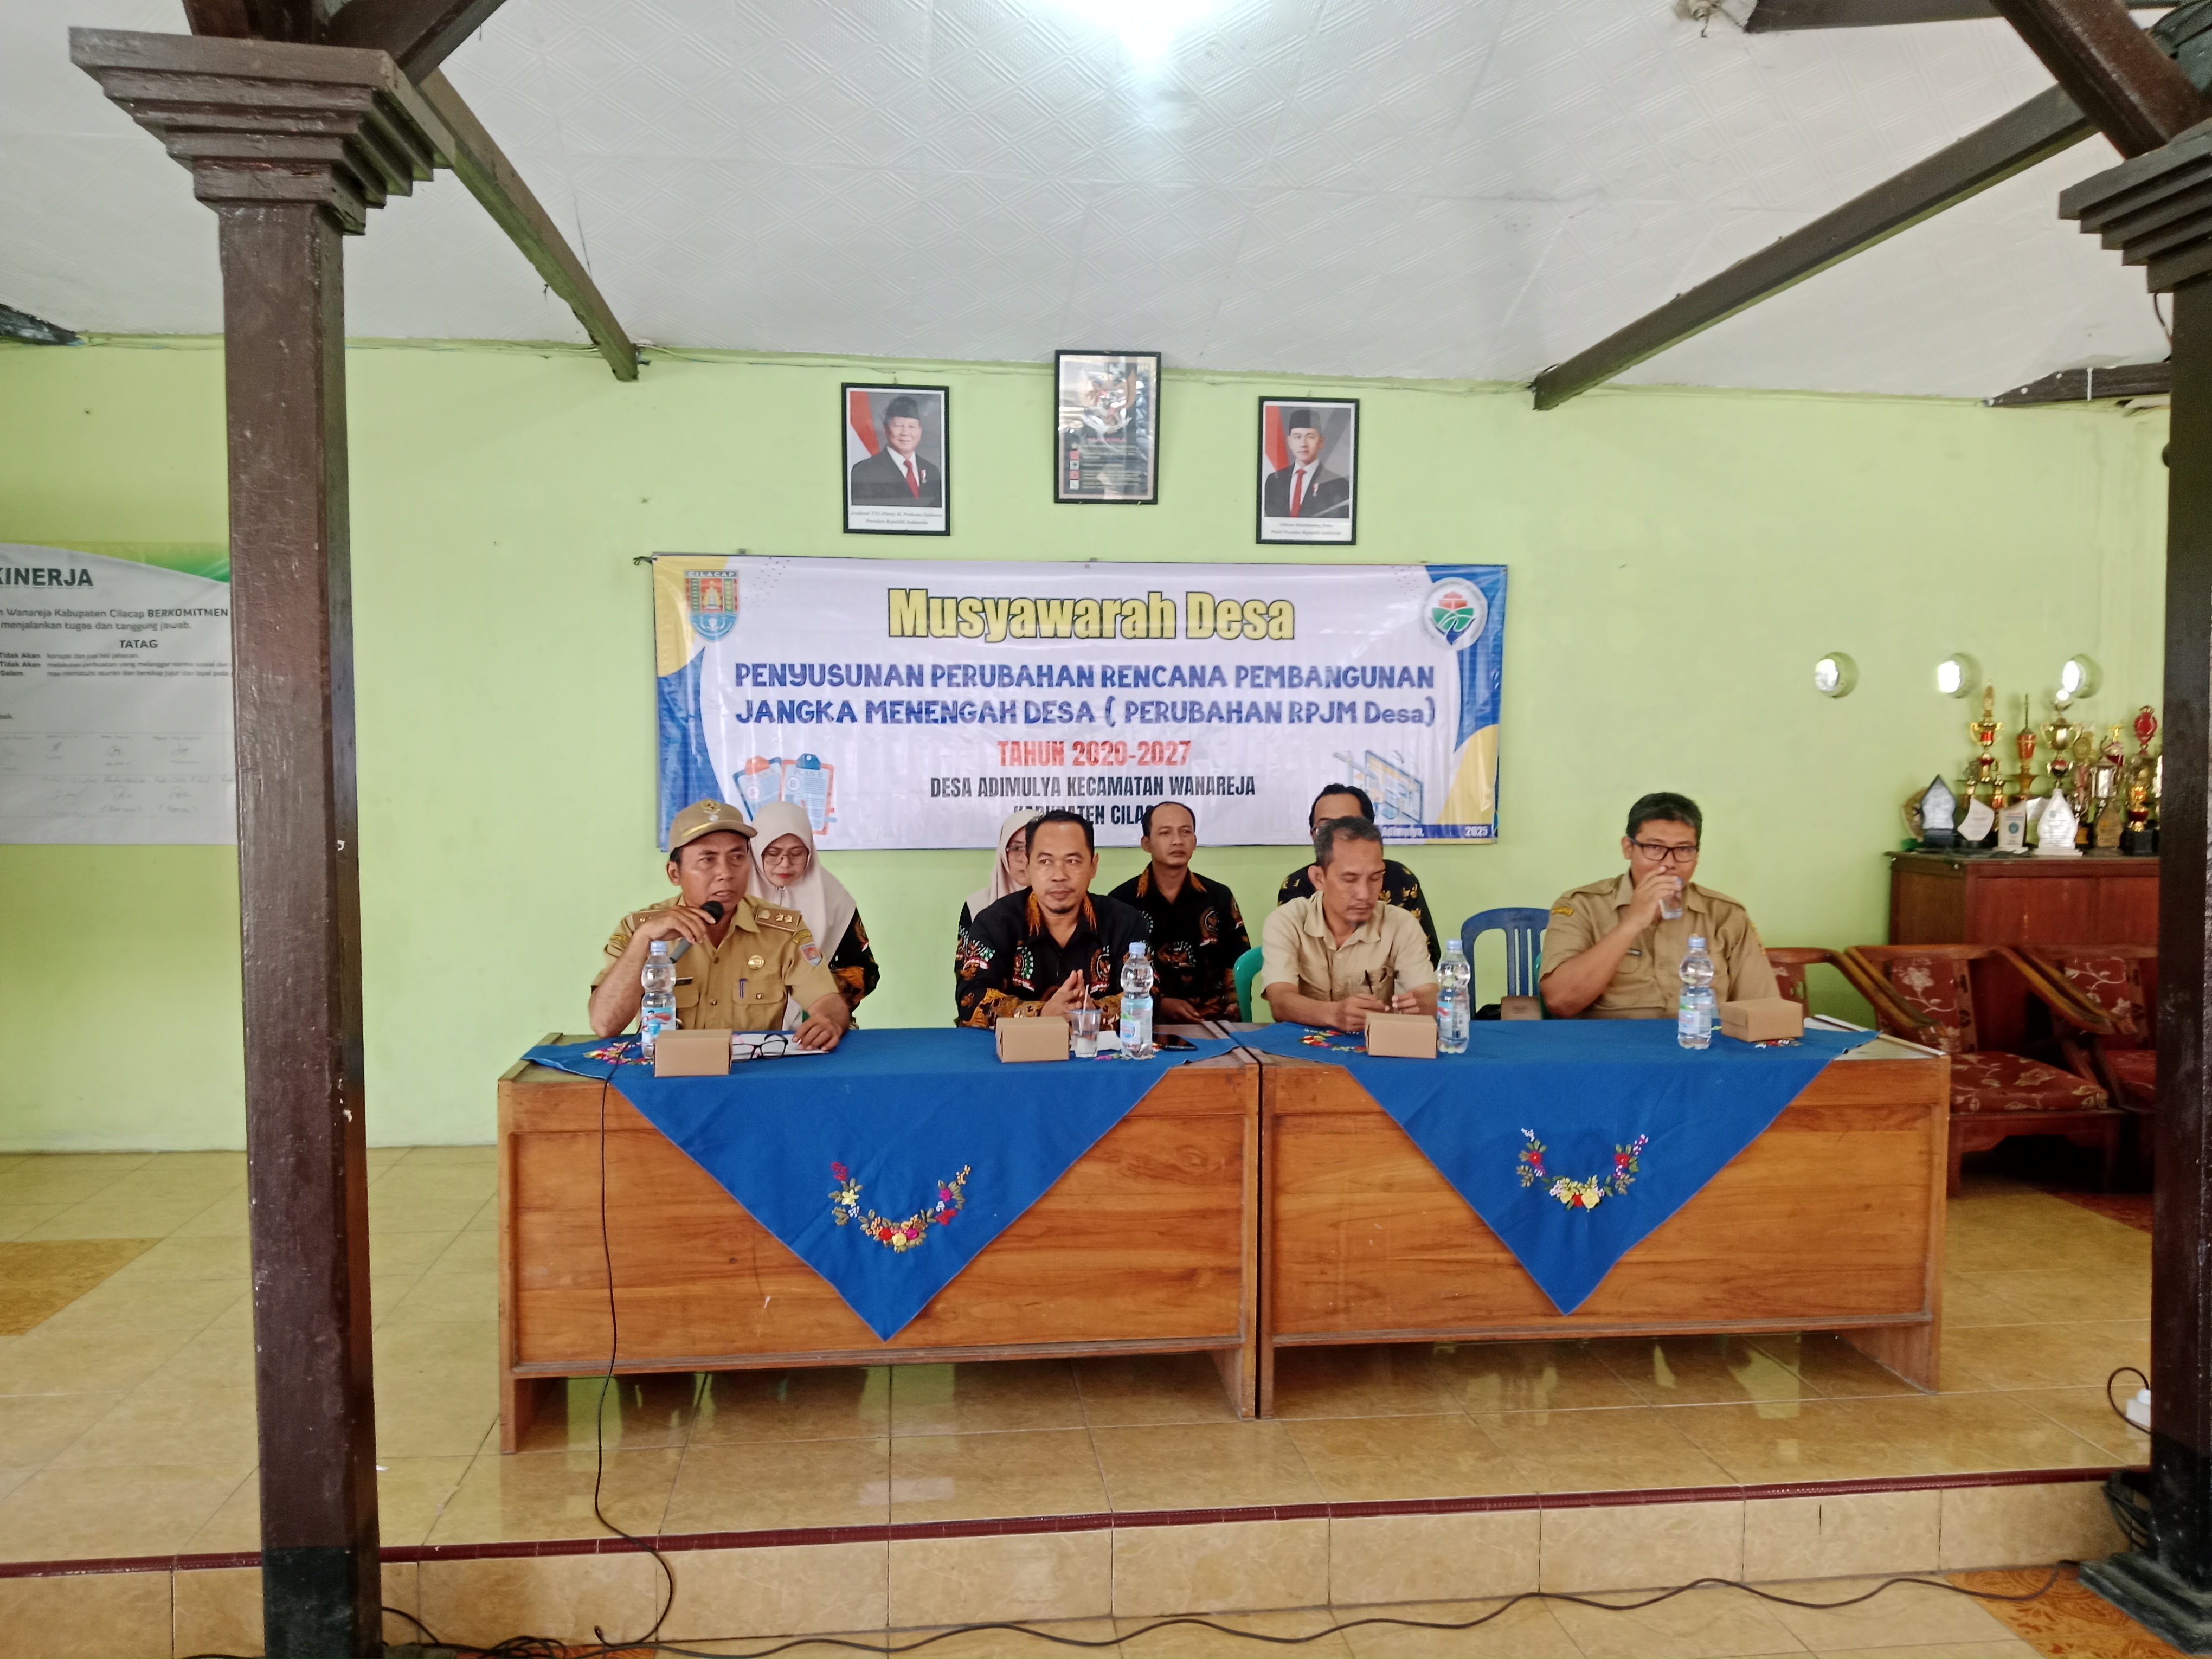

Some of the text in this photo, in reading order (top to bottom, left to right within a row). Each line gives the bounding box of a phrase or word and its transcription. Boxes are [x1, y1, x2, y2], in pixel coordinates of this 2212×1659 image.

[0, 568, 93, 587] INERJA
[6, 608, 51, 618] Wanareja
[54, 608, 106, 618] Kabupaten
[110, 609, 144, 619] Cilacap
[147, 608, 228, 617] BERKOMITMEN
[888, 588, 1295, 642] Musyawarah Desa
[2, 622, 62, 631] menjalankan
[65, 622, 92, 631] tugas
[116, 623, 158, 632] tanggung
[120, 640, 158, 648] TATAG
[735, 663, 1435, 689] PENYUSUNAN PERUBAHAN RENCANA PEMBANGUNAN
[736, 700, 857, 724] JANGKA
[866, 700, 1017, 724] MENENGAH
[1024, 700, 1095, 724] DESA
[1125, 700, 1282, 724] PERUBAHAN
[1288, 700, 1357, 724] RPJM
[1364, 696, 1436, 727] Desa)
[998, 741, 1191, 766] TAHUN 2020-2027
[794, 769, 815, 777] PLAN
[930, 776, 1255, 797] DESA ADIMULYA KECAMATAN WANAREJA
[1465, 826, 1488, 837] 2025
